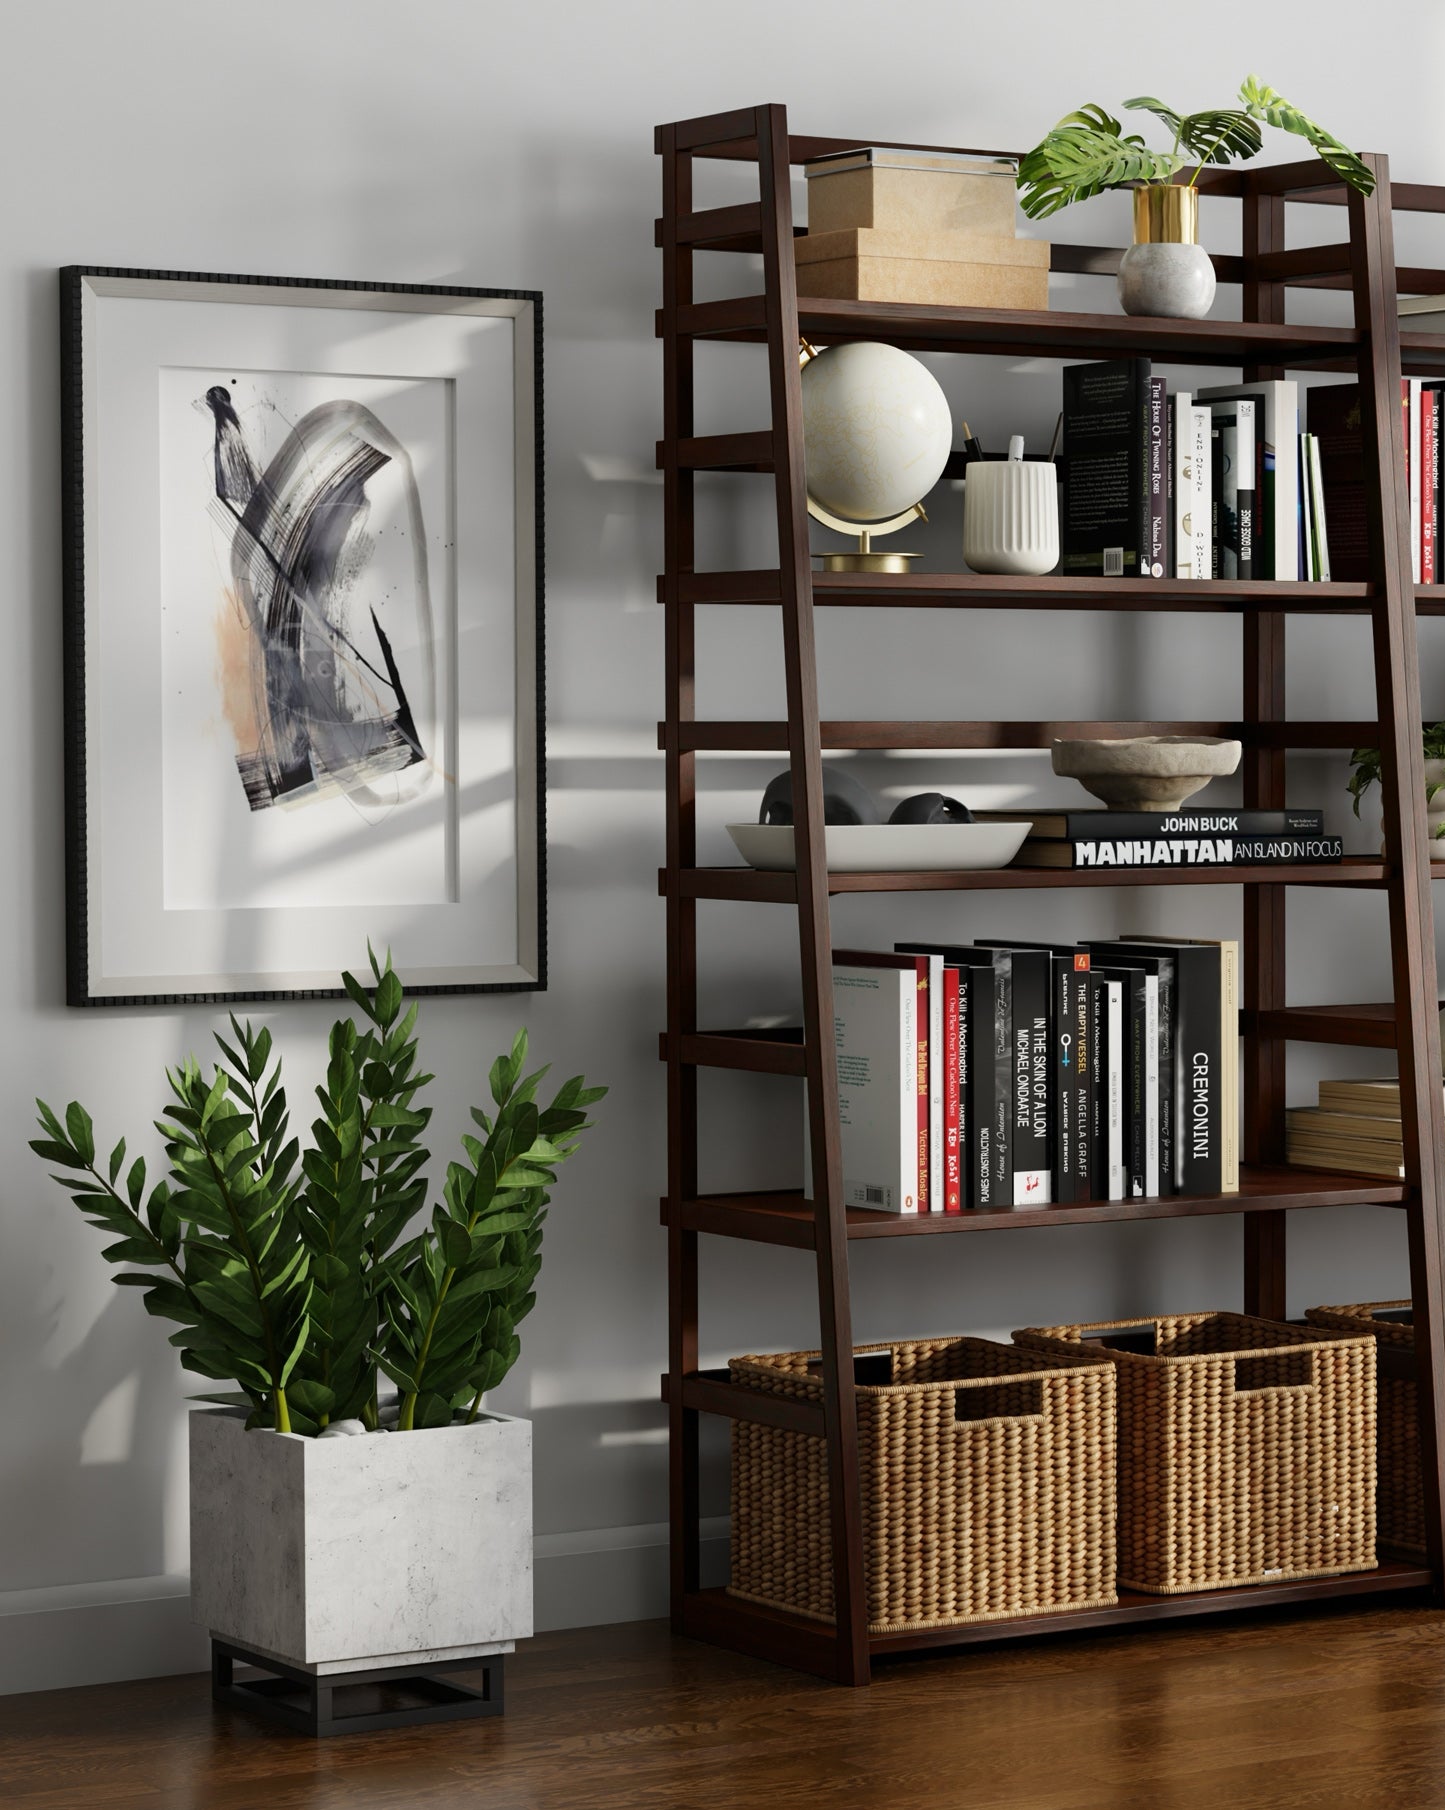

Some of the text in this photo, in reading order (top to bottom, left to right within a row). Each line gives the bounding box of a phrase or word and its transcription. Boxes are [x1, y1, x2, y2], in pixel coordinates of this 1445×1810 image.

[1152, 383, 1162, 398] THE
[1152, 400, 1162, 423] HOUSE
[1432, 405, 1439, 414] To
[1152, 439, 1162, 471] TWINING
[1152, 473, 1162, 494] ROSES
[1152, 543, 1162, 558] Das
[1241, 509, 1251, 560] WILD GOOSE CHASE
[1160, 817, 1238, 833] JOHN BUCK
[1075, 839, 1233, 866] MANHATTAN
[1233, 841, 1342, 859] AN ISLAND IN FOCUS
[1078, 957, 1086, 969] 4
[960, 983, 968, 995] To
[960, 997, 968, 1013] Kill
[1094, 988, 1100, 999] To
[1078, 983, 1087, 1075] THE EMPTY VESSEL
[949, 997, 957, 1117] One Flew Over The Cuckoo's Nest
[960, 1023, 968, 1084] Mockingbird
[1133, 1017, 1141, 1115] AWAY FROM EVERYWHERE
[1017, 1029, 1029, 1128] MICHAEL ONDAATJE
[1034, 1017, 1047, 1138] IN THE SKIN OF A LION
[1193, 1052, 1209, 1159] CREMONINI
[1078, 1088, 1087, 1177] ANGELLA GRAFF
[918, 1128, 928, 1202] Victoria Mosley
[980, 1127, 990, 1202] PLANES CONSTRUCTION
[996, 1144, 1007, 1182] House of
[1162, 1138, 1171, 1174] House of
